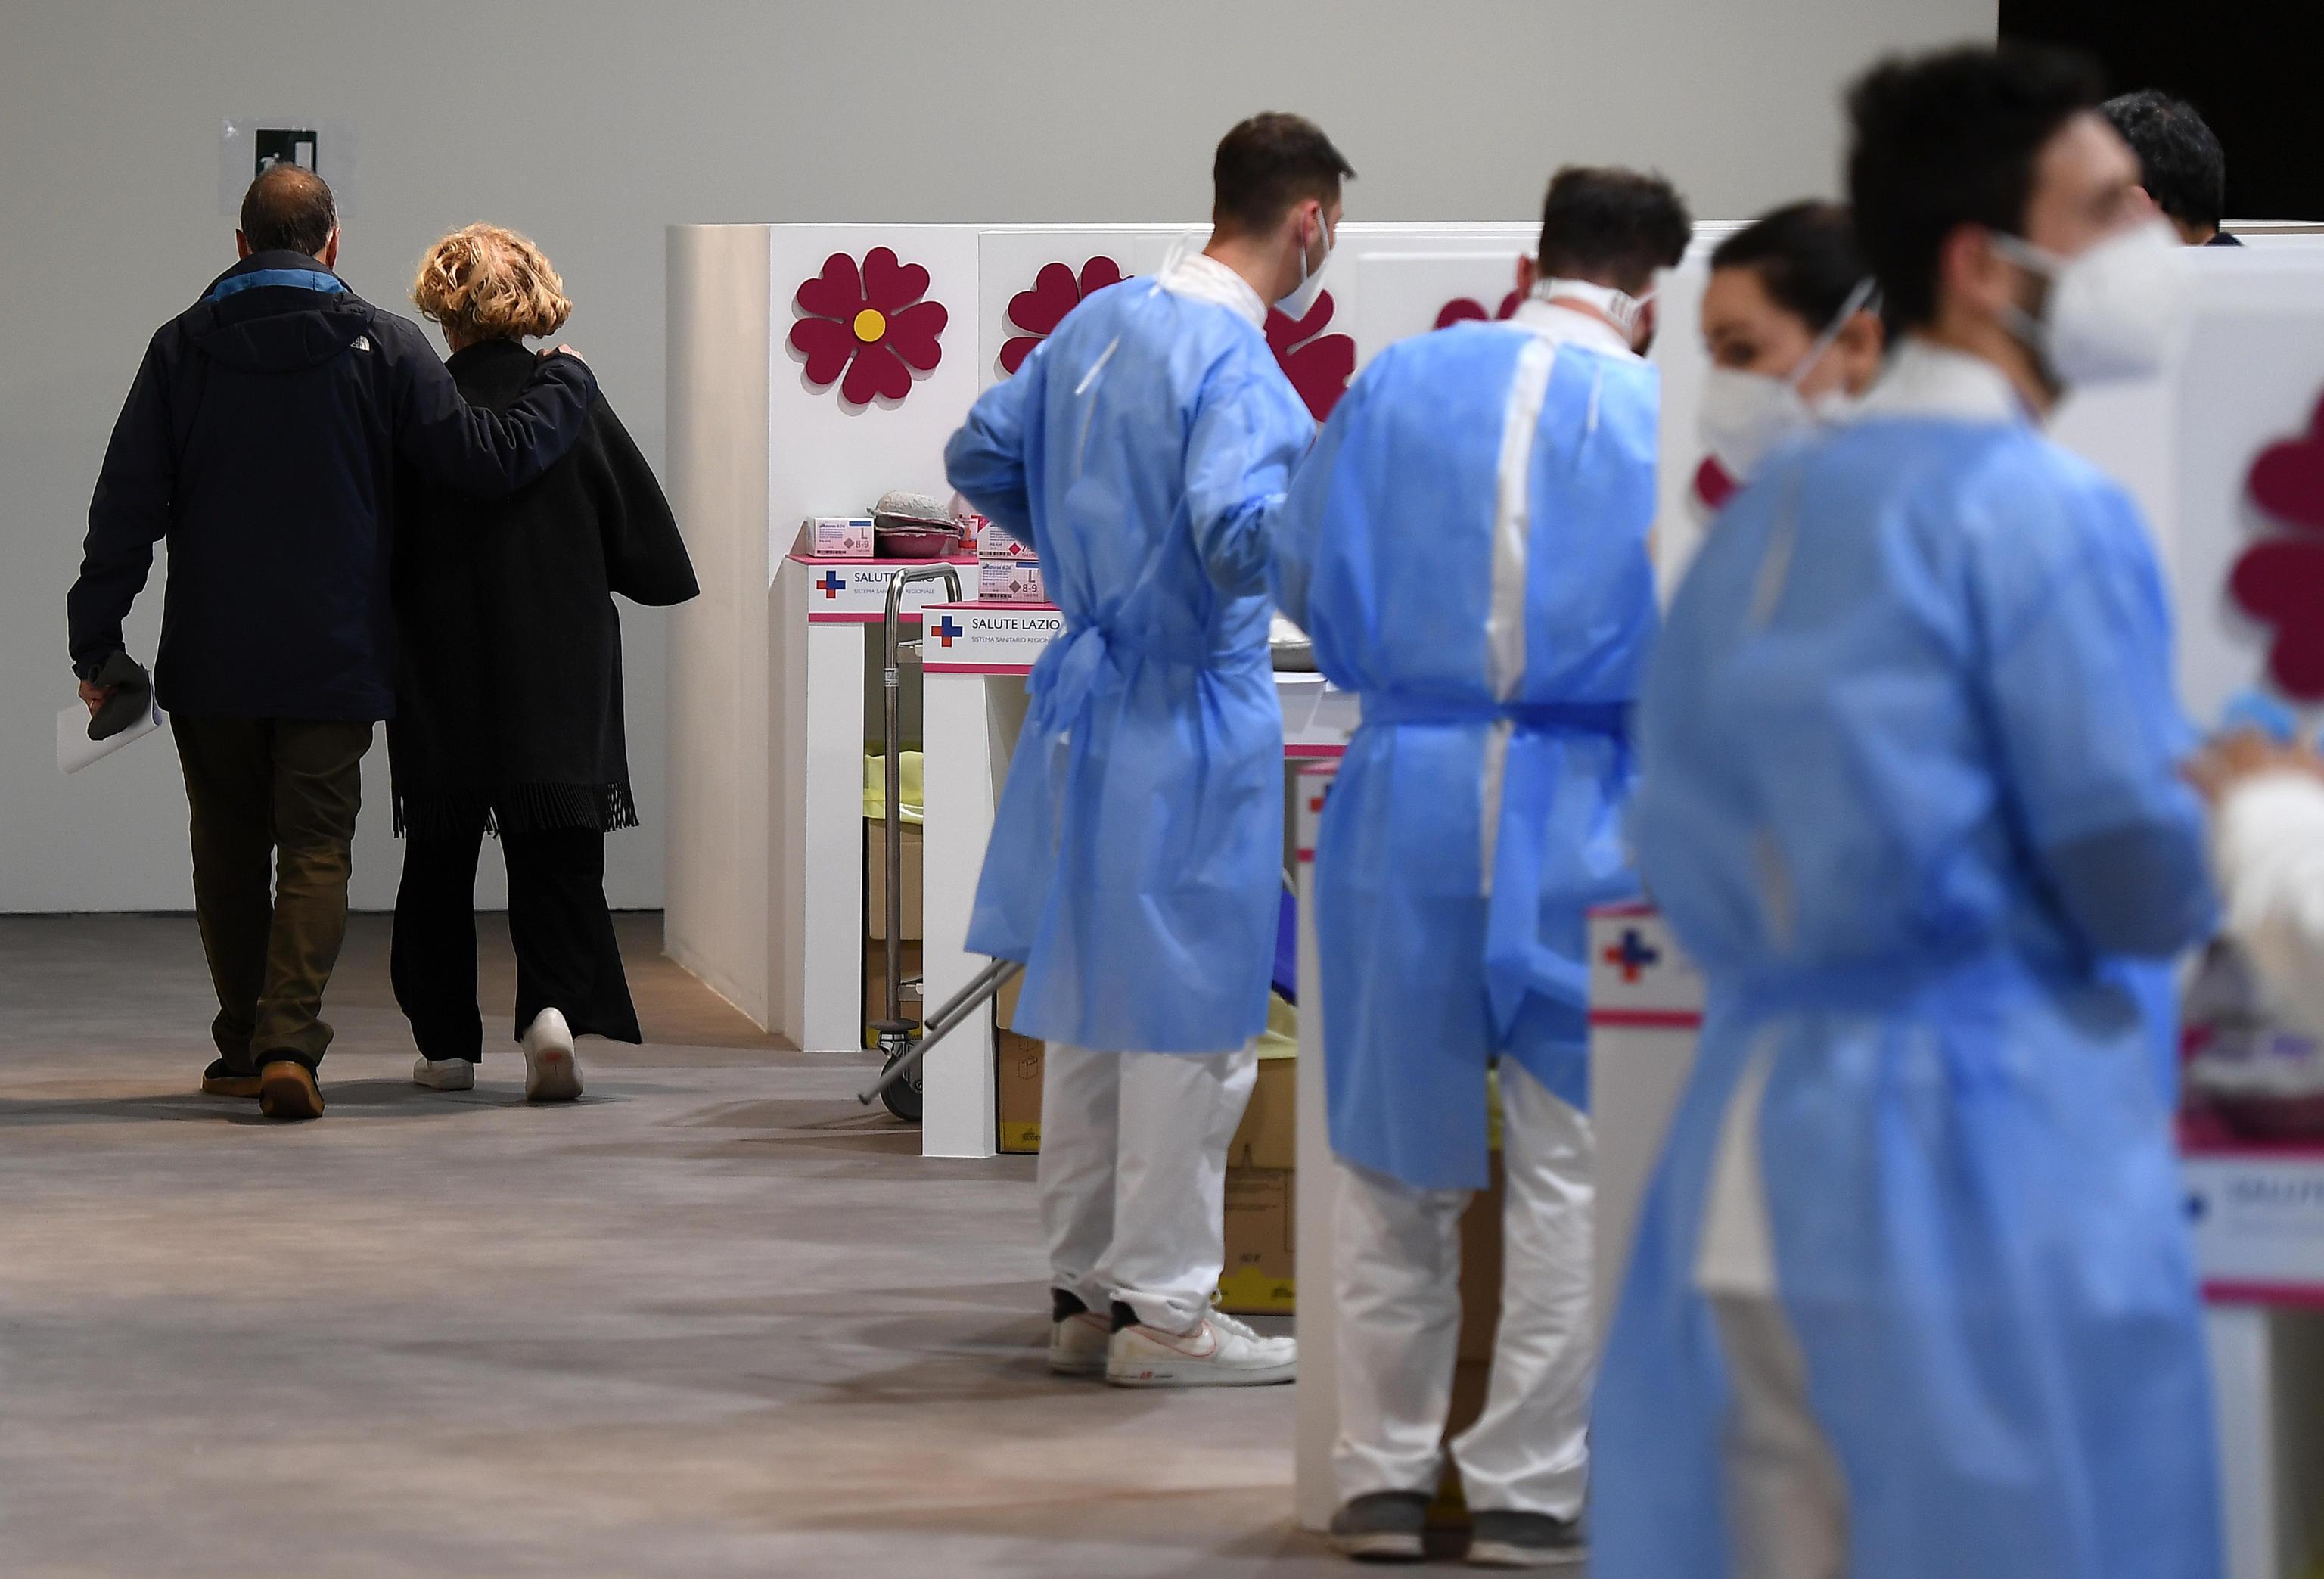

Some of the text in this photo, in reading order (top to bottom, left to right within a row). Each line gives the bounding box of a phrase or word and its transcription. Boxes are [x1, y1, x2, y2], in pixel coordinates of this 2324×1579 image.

[861, 527, 868, 539] L
[1029, 570, 1036, 583] L
[1022, 583, 1037, 592] 8-9
[972, 618, 1061, 630] SALUTE LAZIO
